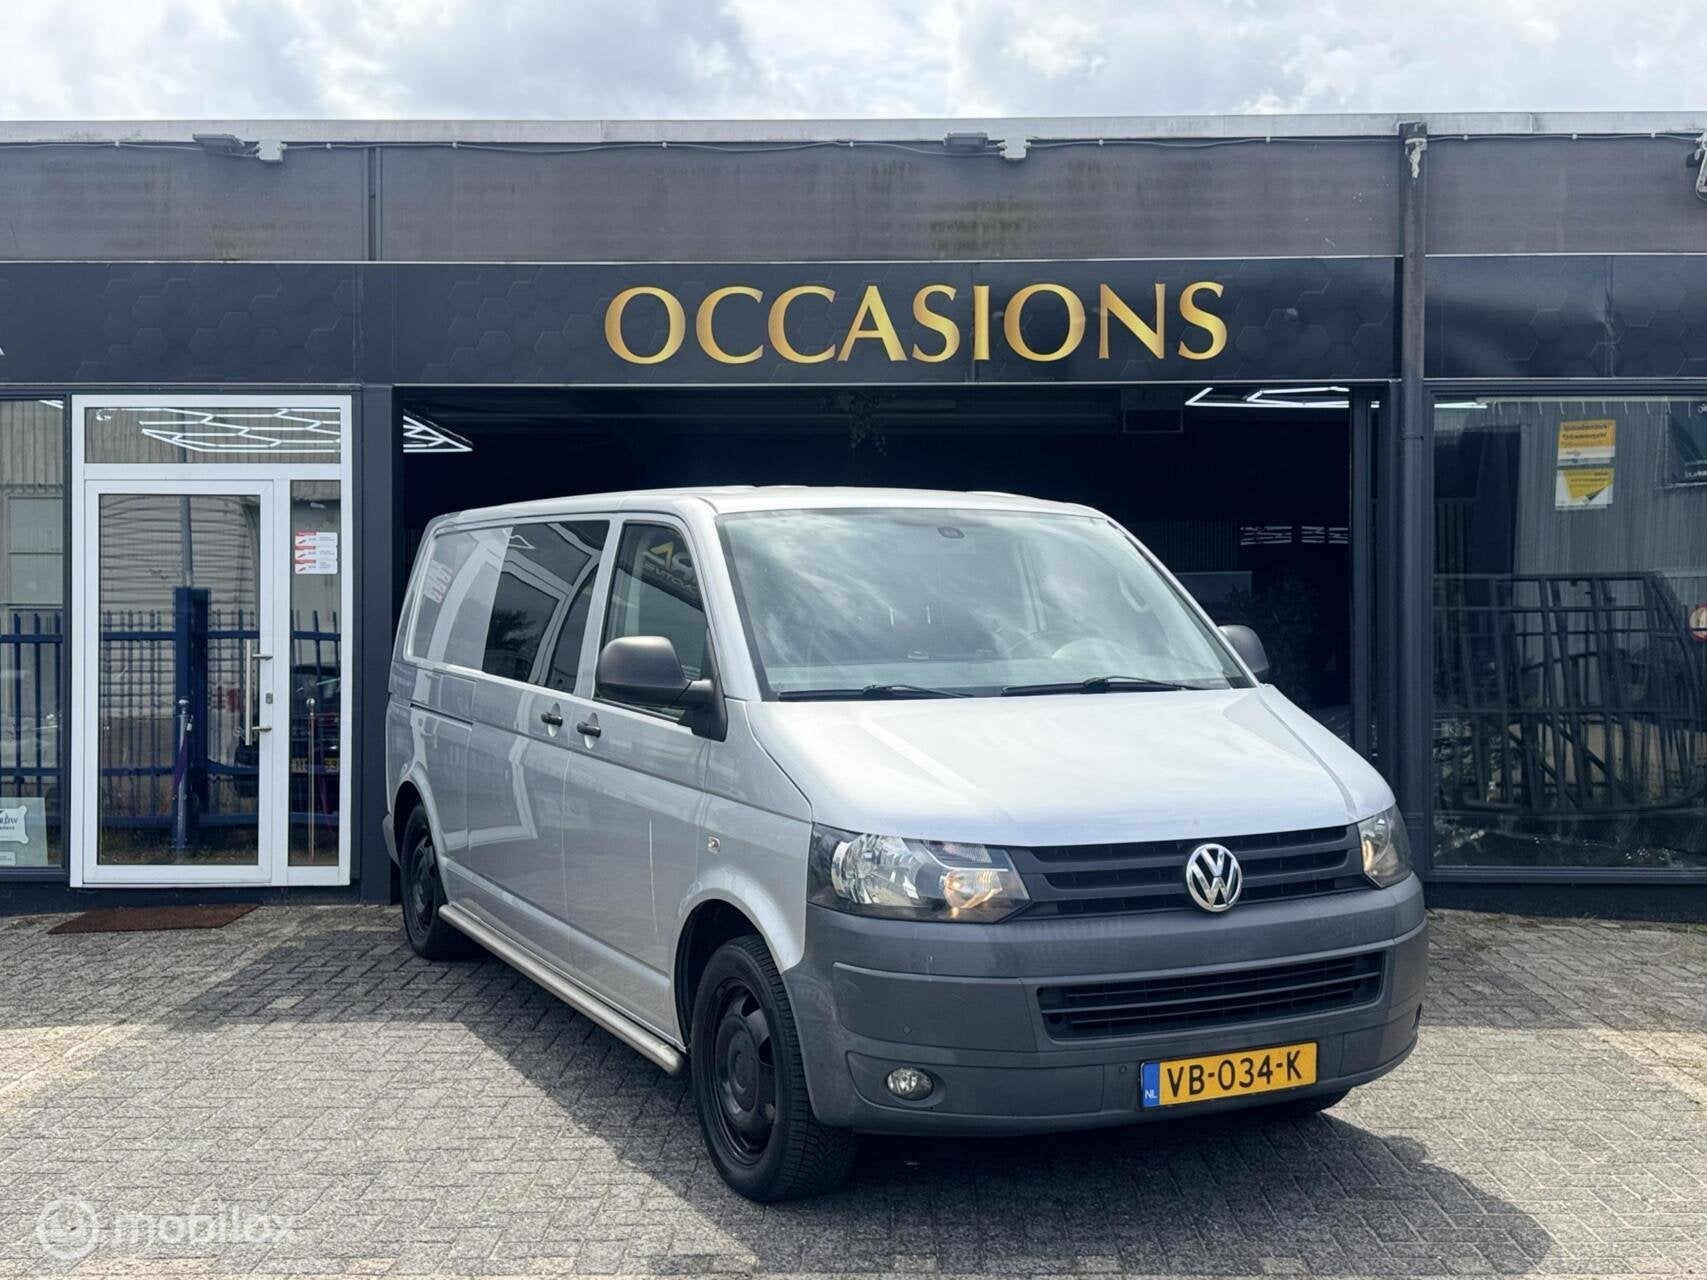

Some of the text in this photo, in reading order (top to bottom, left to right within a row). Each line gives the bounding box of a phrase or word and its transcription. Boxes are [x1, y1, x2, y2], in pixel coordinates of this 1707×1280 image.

[604, 282, 1228, 364] OCCASIONS
[1144, 1089, 1158, 1099] NL
[1167, 1050, 1302, 1098] VB-034-K
